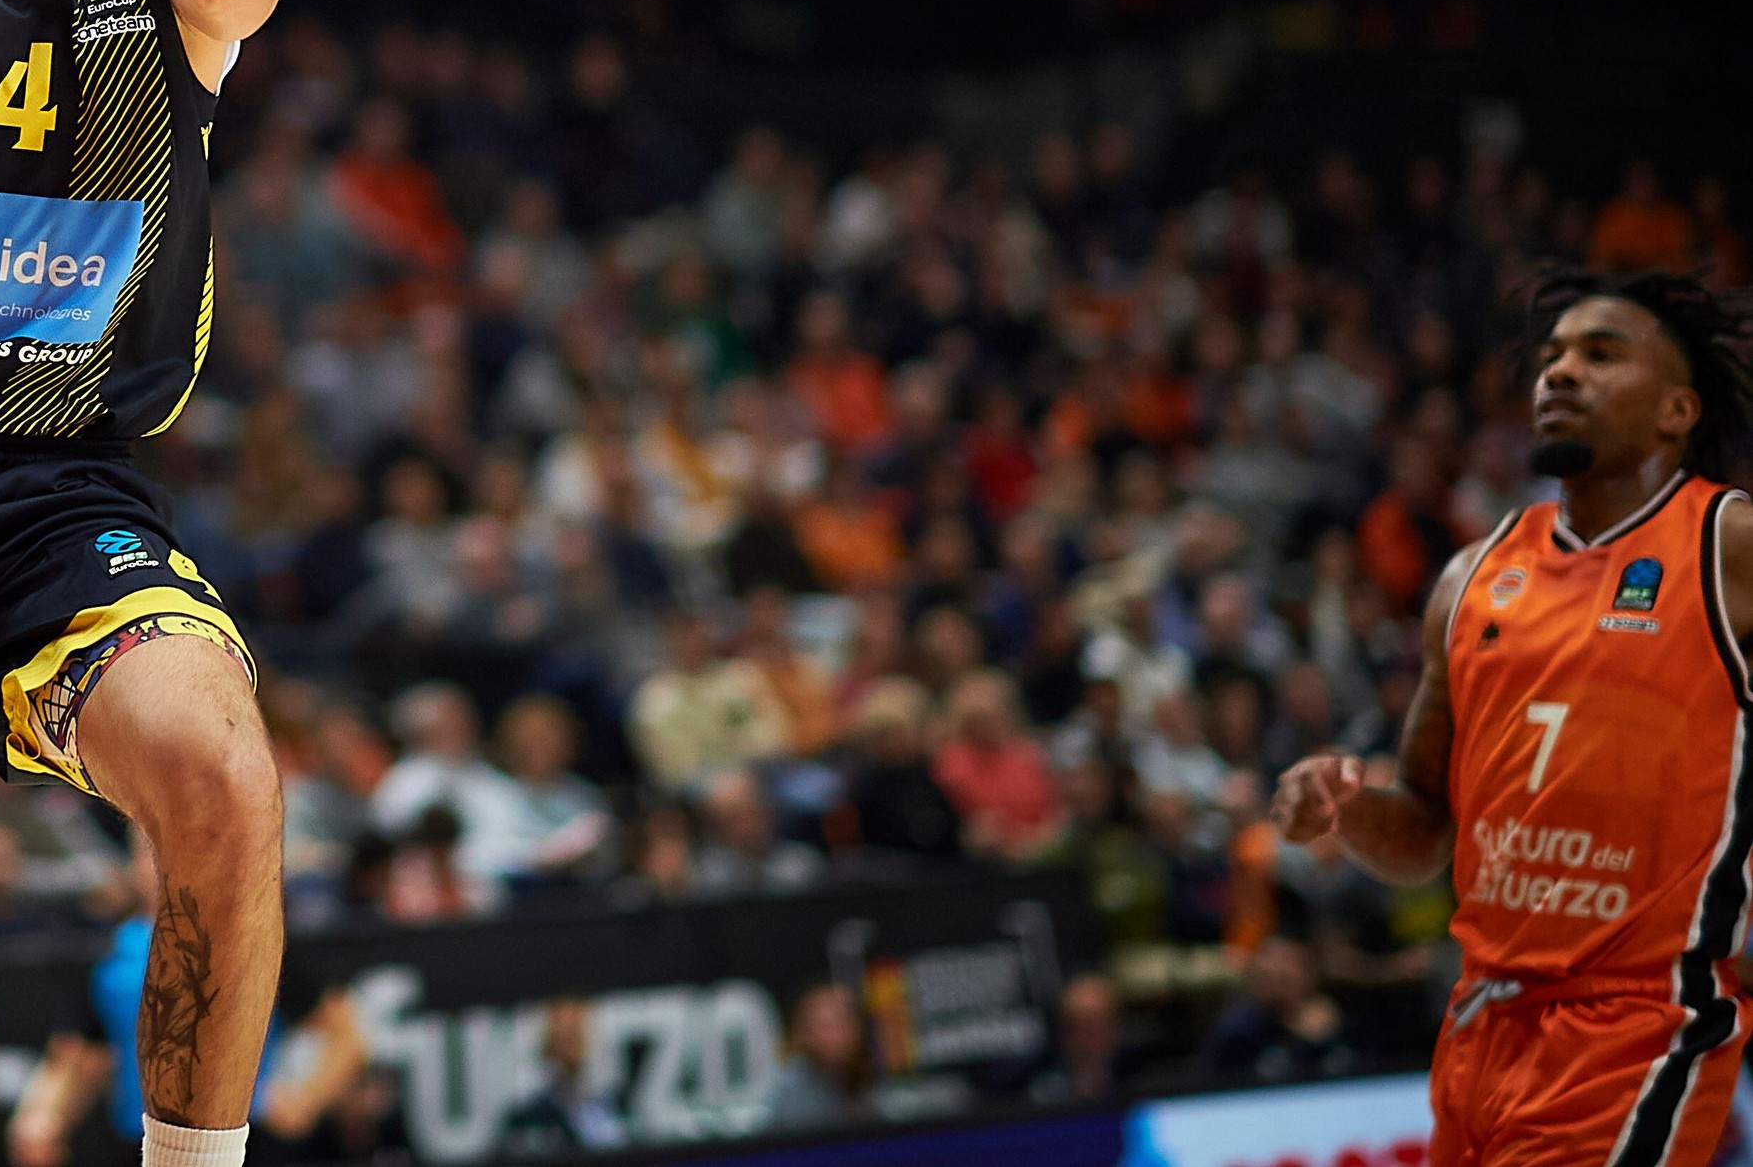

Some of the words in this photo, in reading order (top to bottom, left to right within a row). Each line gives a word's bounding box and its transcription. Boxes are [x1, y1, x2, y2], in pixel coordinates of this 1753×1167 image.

[77, 15, 156, 43] oneteam
[18, 345, 94, 365] GROUP
[1527, 701, 1569, 793] 7
[1592, 844, 1636, 871] del
